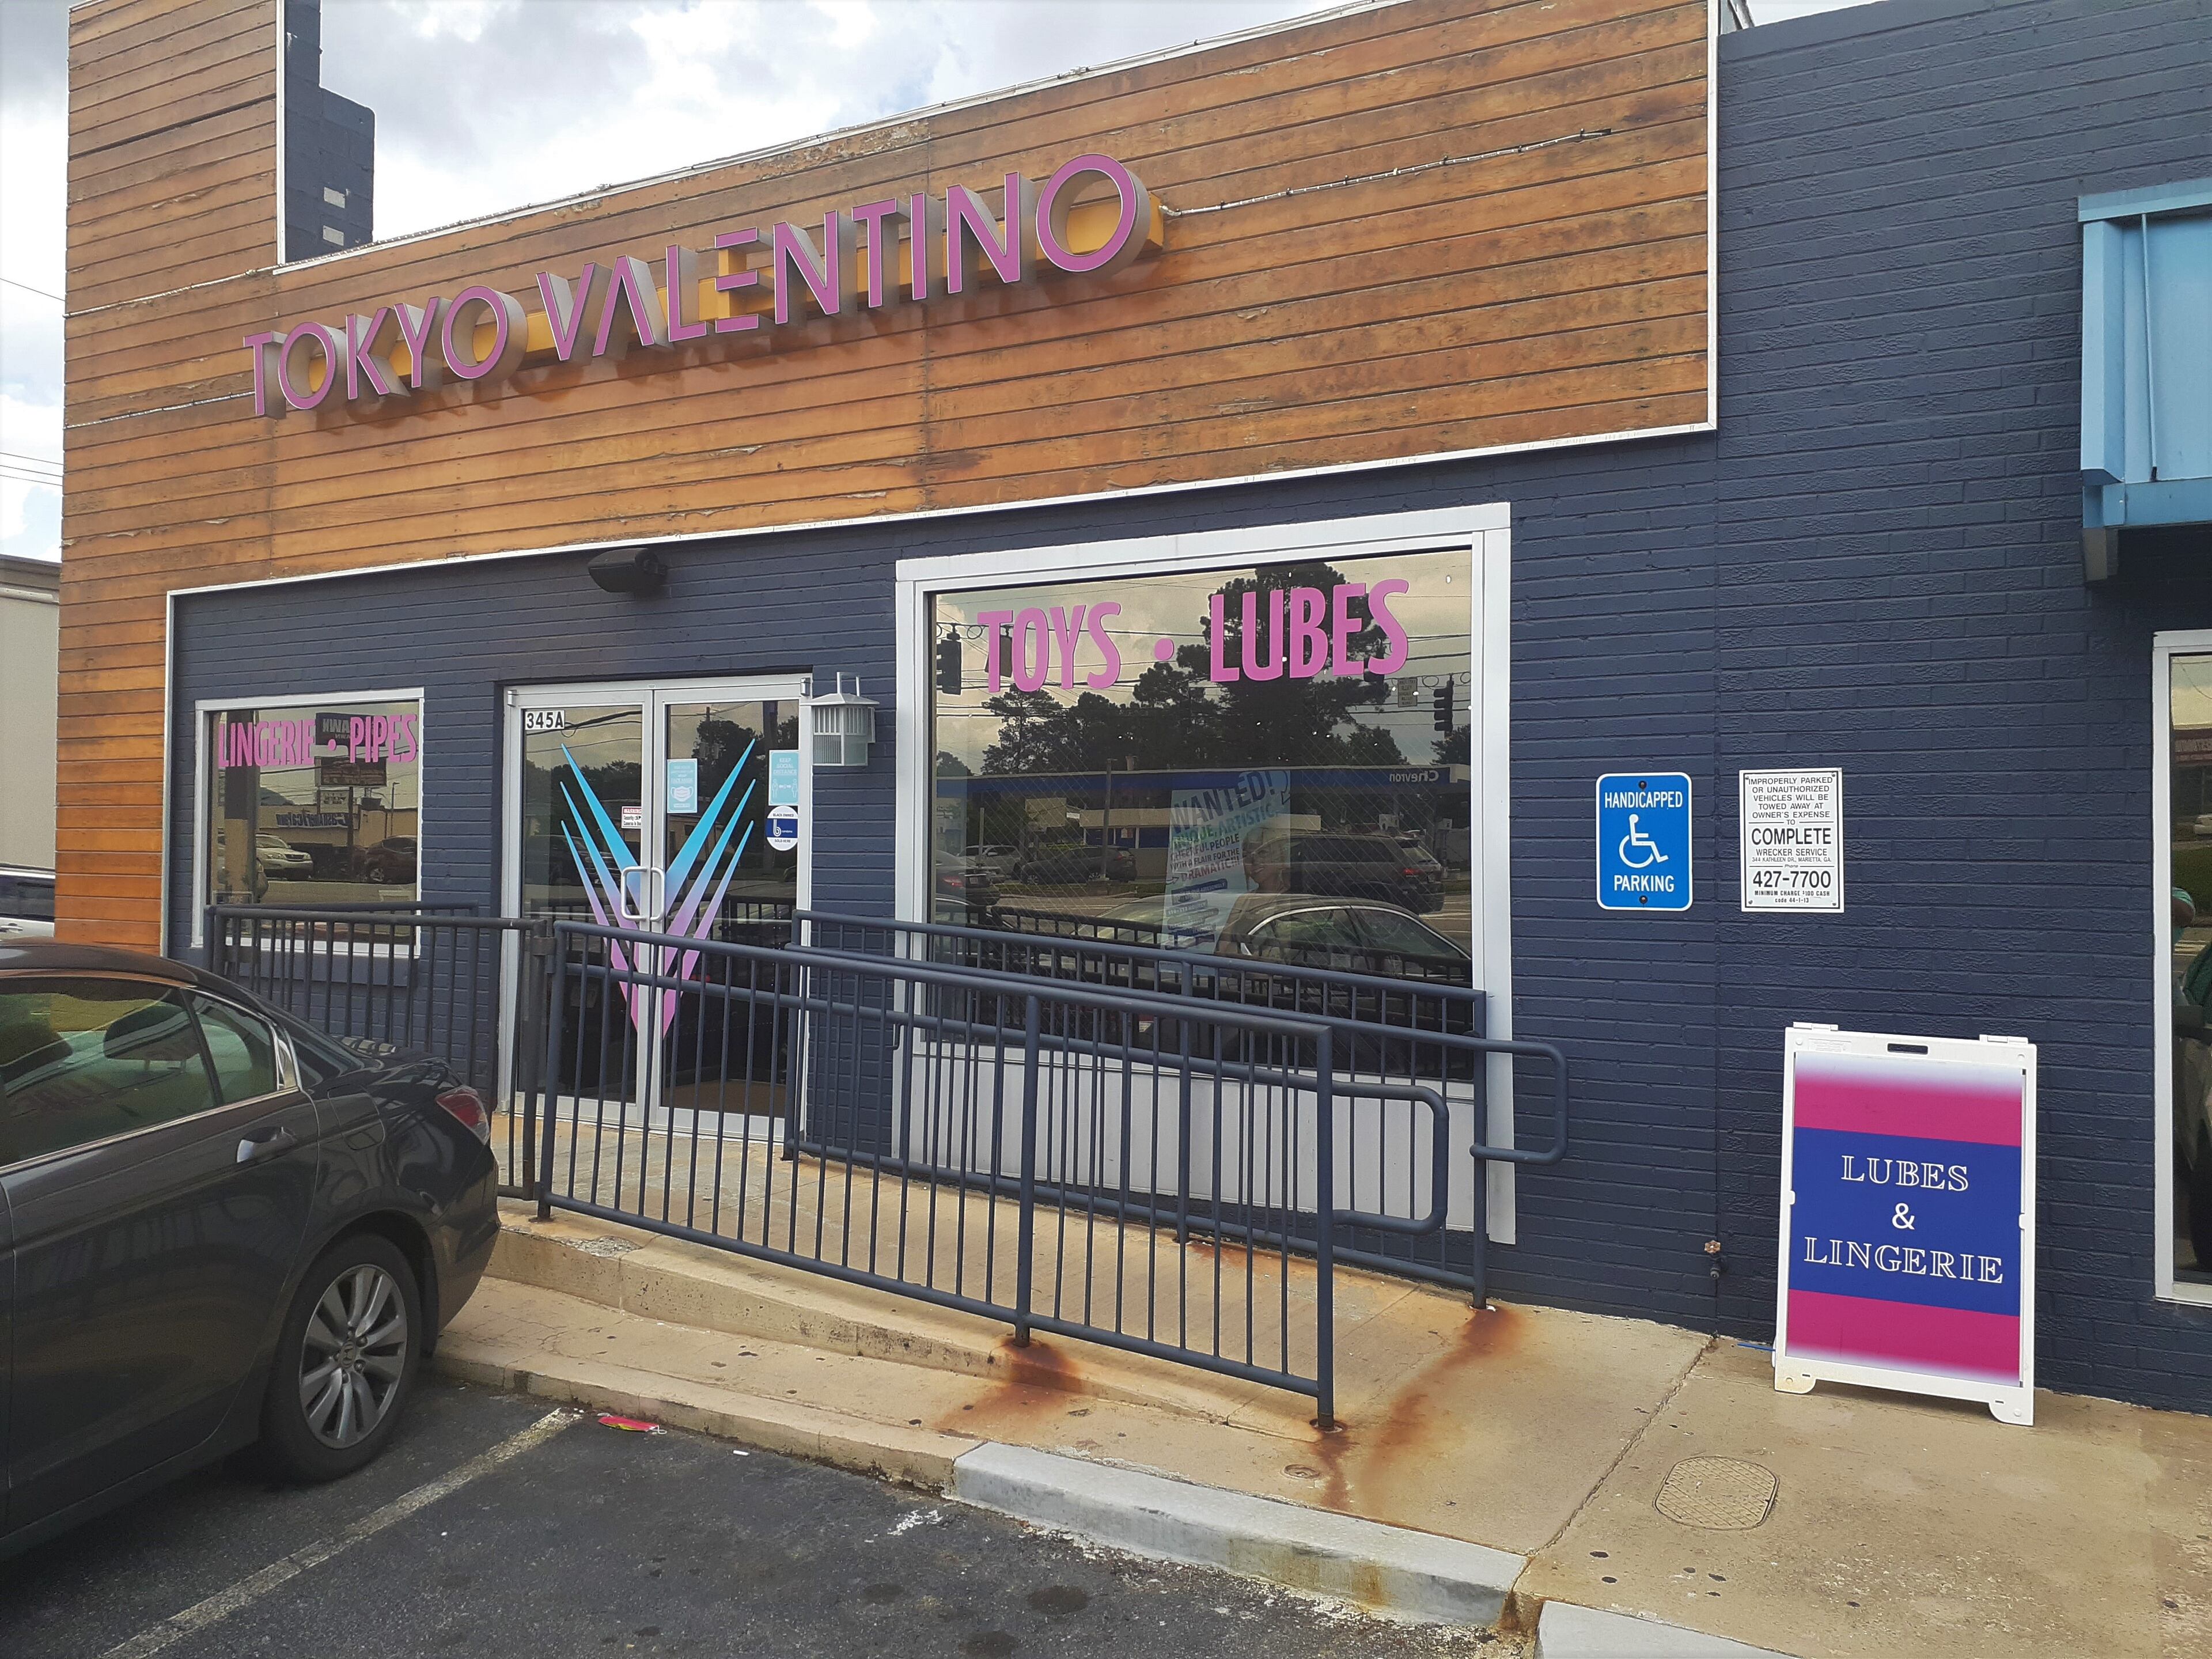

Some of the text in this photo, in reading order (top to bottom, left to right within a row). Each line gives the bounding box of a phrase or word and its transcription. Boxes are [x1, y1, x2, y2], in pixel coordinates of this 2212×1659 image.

[243, 153, 1137, 416] TOKYO VALENTINO
[976, 578, 1409, 693] TOYS LUBES
[527, 711, 564, 729] 345A
[218, 714, 418, 767] LINGERIE PIPES
[1748, 777, 1797, 785] IMPROPERLY
[1170, 769, 1275, 834] WANTED!
[1604, 791, 1683, 809] HANDICAPPED
[1210, 833, 1240, 849] PEOPLE
[1751, 828, 1831, 845] COMPLETE
[1194, 854, 1211, 866] FLAIR
[1213, 850, 1226, 860] FOR
[1226, 847, 1240, 857] THE
[1796, 848, 1827, 856] SERVICE
[1613, 874, 1675, 892] PARKING
[1752, 870, 1831, 888] 427-7700
[1840, 1154, 1969, 1192] LUBES
[1891, 1202, 1916, 1231] &
[1803, 1236, 2004, 1285] LINGERIE
